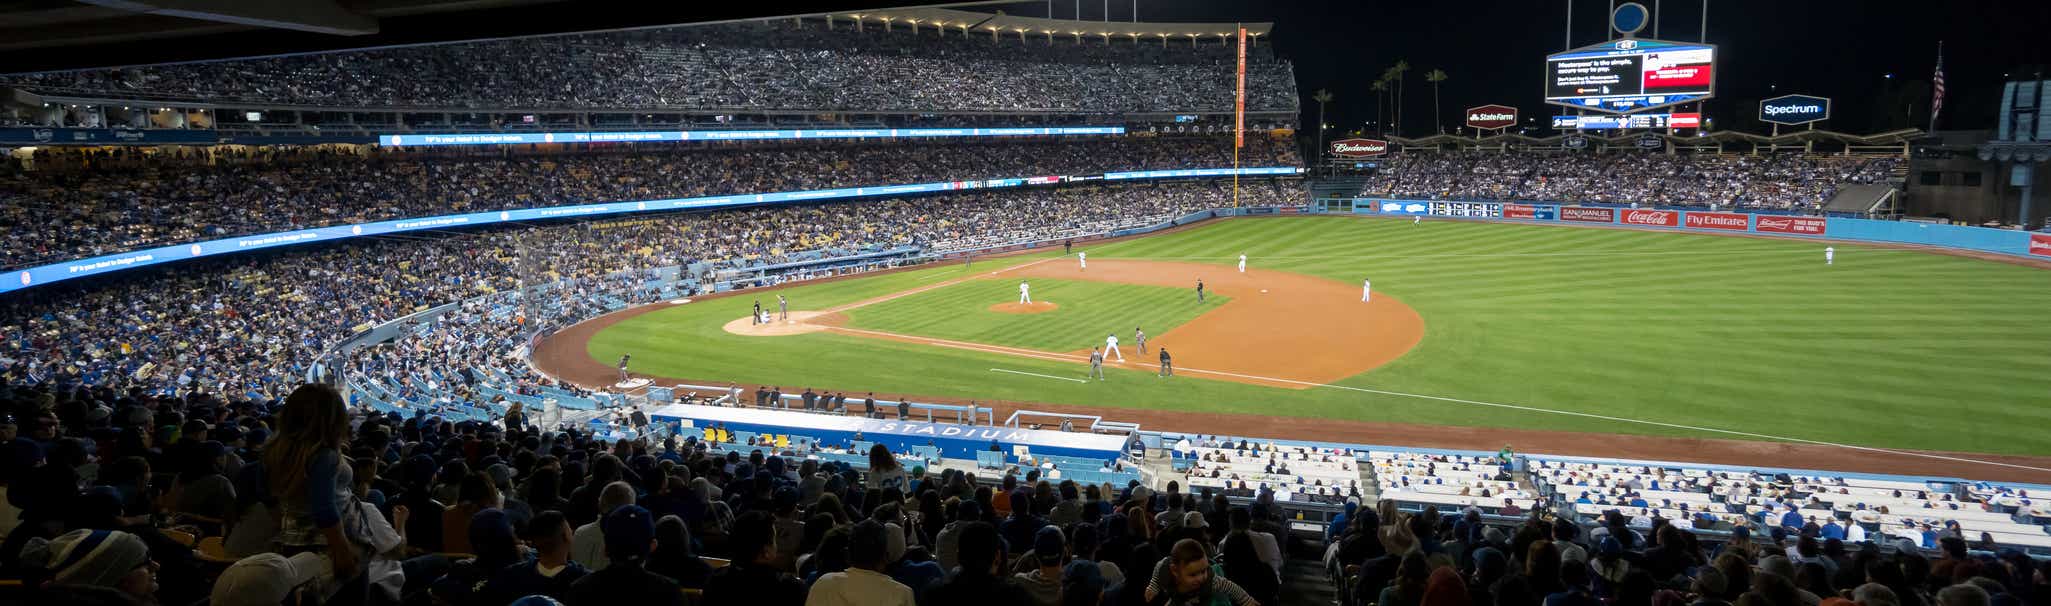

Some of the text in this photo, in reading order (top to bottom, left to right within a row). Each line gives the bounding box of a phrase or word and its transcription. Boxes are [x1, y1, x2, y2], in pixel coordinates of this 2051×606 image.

[1765, 105, 1818, 116] Spectrum
[1334, 144, 1384, 152] Budweiser
[1687, 215, 1746, 226] Fly Emirates
[880, 422, 1028, 441] STADIUM
